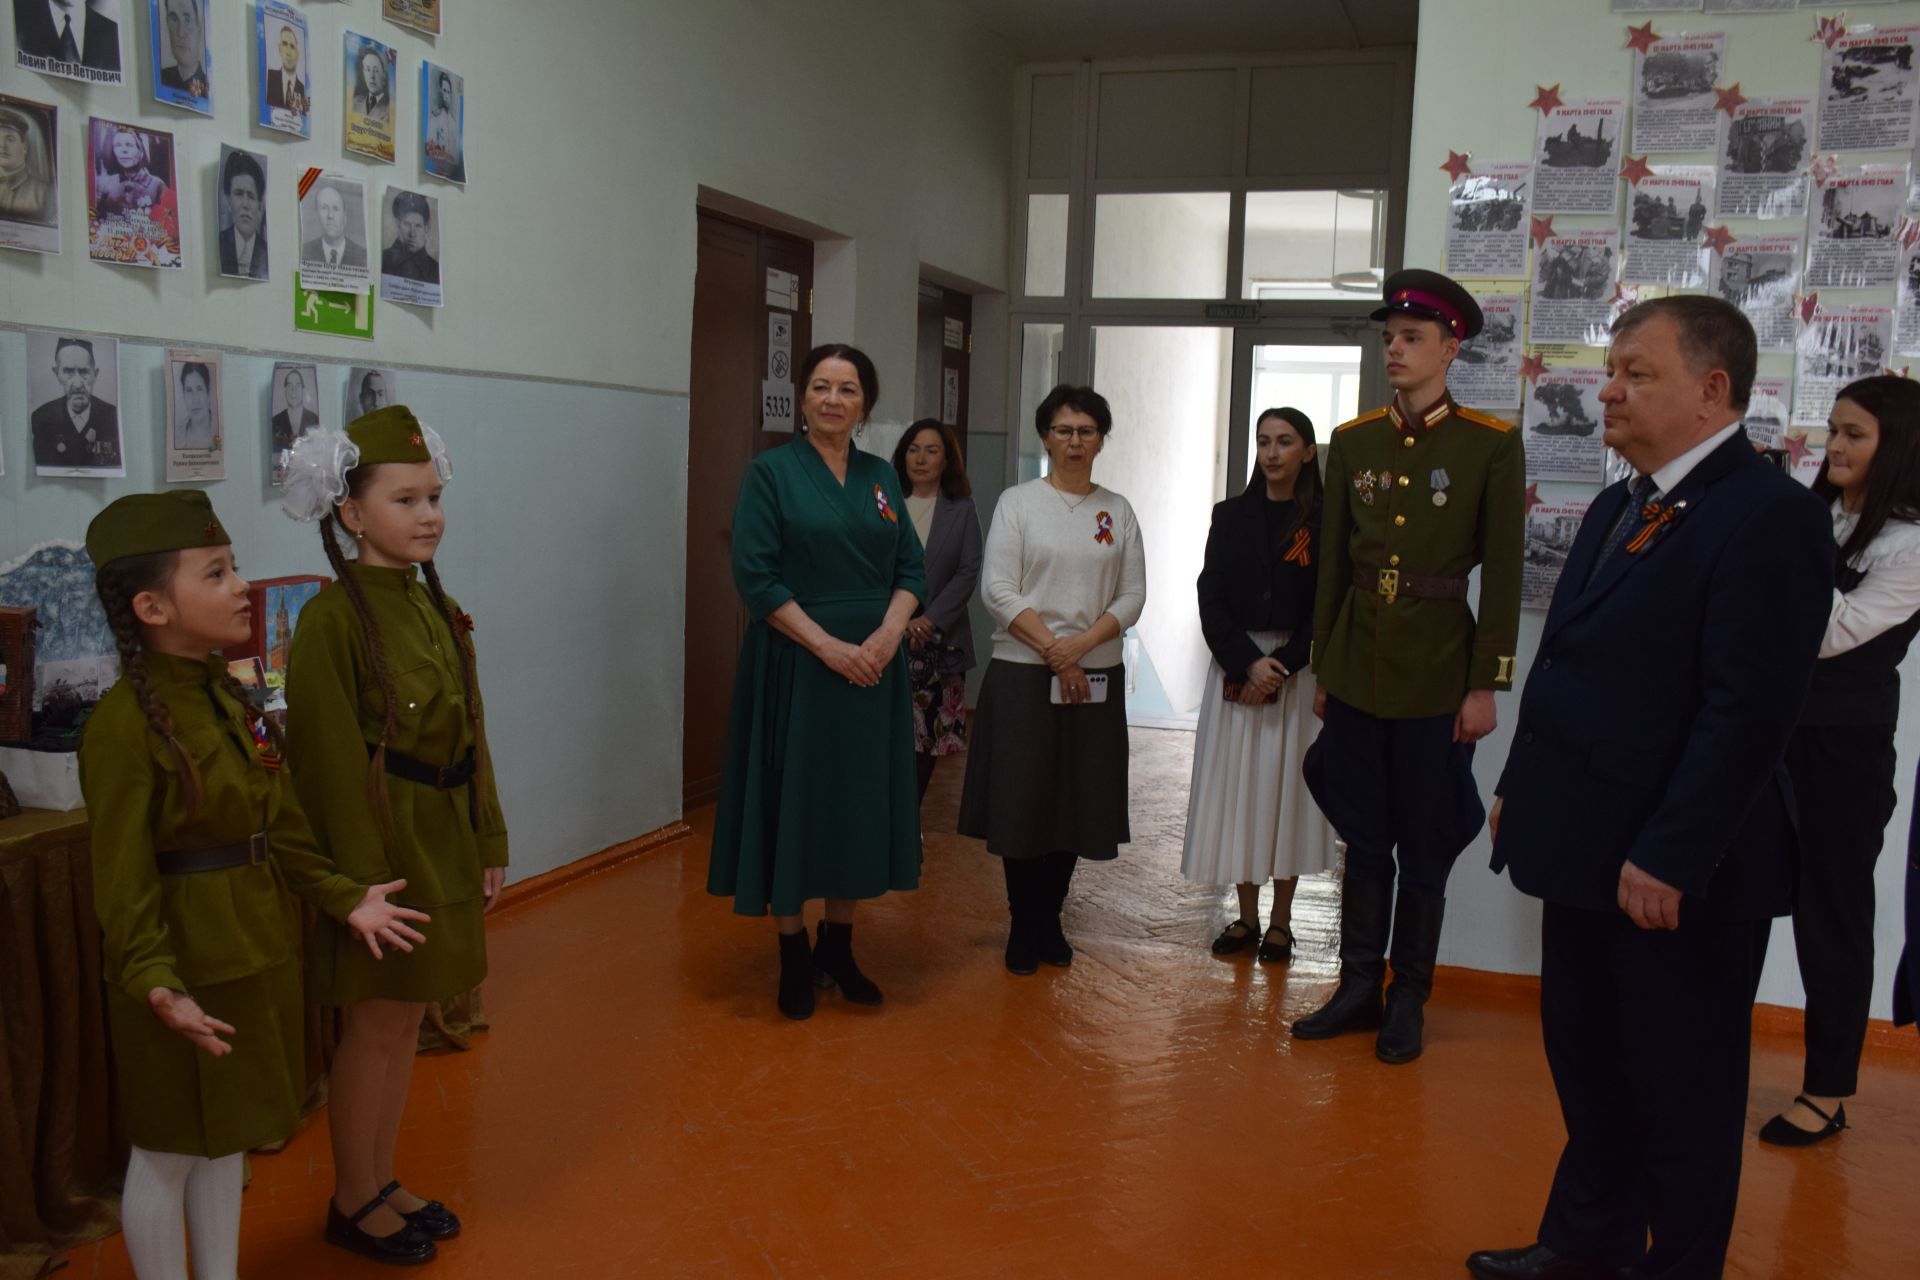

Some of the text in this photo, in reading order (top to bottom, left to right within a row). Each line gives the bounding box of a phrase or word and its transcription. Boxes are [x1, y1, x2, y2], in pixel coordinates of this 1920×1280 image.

[1849, 39, 1872, 47] МАРТА
[1873, 37, 1889, 45] 1945
[1890, 35, 1909, 44] ГОДА
[1661, 44, 1682, 52] МАРТА
[1683, 43, 1697, 51] 1945
[1698, 42, 1714, 50] ГОДА
[48, 57, 73, 76] Петр
[73, 63, 122, 84] Петрович
[1561, 109, 1582, 117] МАРТА
[1583, 108, 1597, 116] 1945
[1597, 107, 1613, 116] ГОДА
[1746, 108, 1769, 116] МАРТА
[1770, 107, 1784, 115] 1945
[1785, 106, 1802, 115] ГОДА
[1503, 172, 1520, 180] ГОДА
[1649, 178, 1670, 187] МАРТА
[1671, 178, 1685, 187] 1945
[1685, 178, 1702, 187] ГОДА
[1837, 179, 1860, 188] МАРТА
[1861, 178, 1876, 187] 1945
[1877, 177, 1895, 186] ГОДА
[1556, 238, 1577, 246] МАРТА
[1577, 238, 1592, 246] 1945
[1592, 238, 1608, 246] ГОДА
[1735, 244, 1758, 253] МАРТА
[1759, 244, 1774, 252] 1945
[1208, 305, 1254, 319] ВЫХОД
[1862, 315, 1879, 323] ГОДА
[1569, 377, 1582, 385] 1945
[1761, 388, 1778, 396] ГОДА
[765, 395, 791, 418] 5332
[1540, 506, 1561, 514] МАРТА
[1561, 507, 1575, 515] 1945
